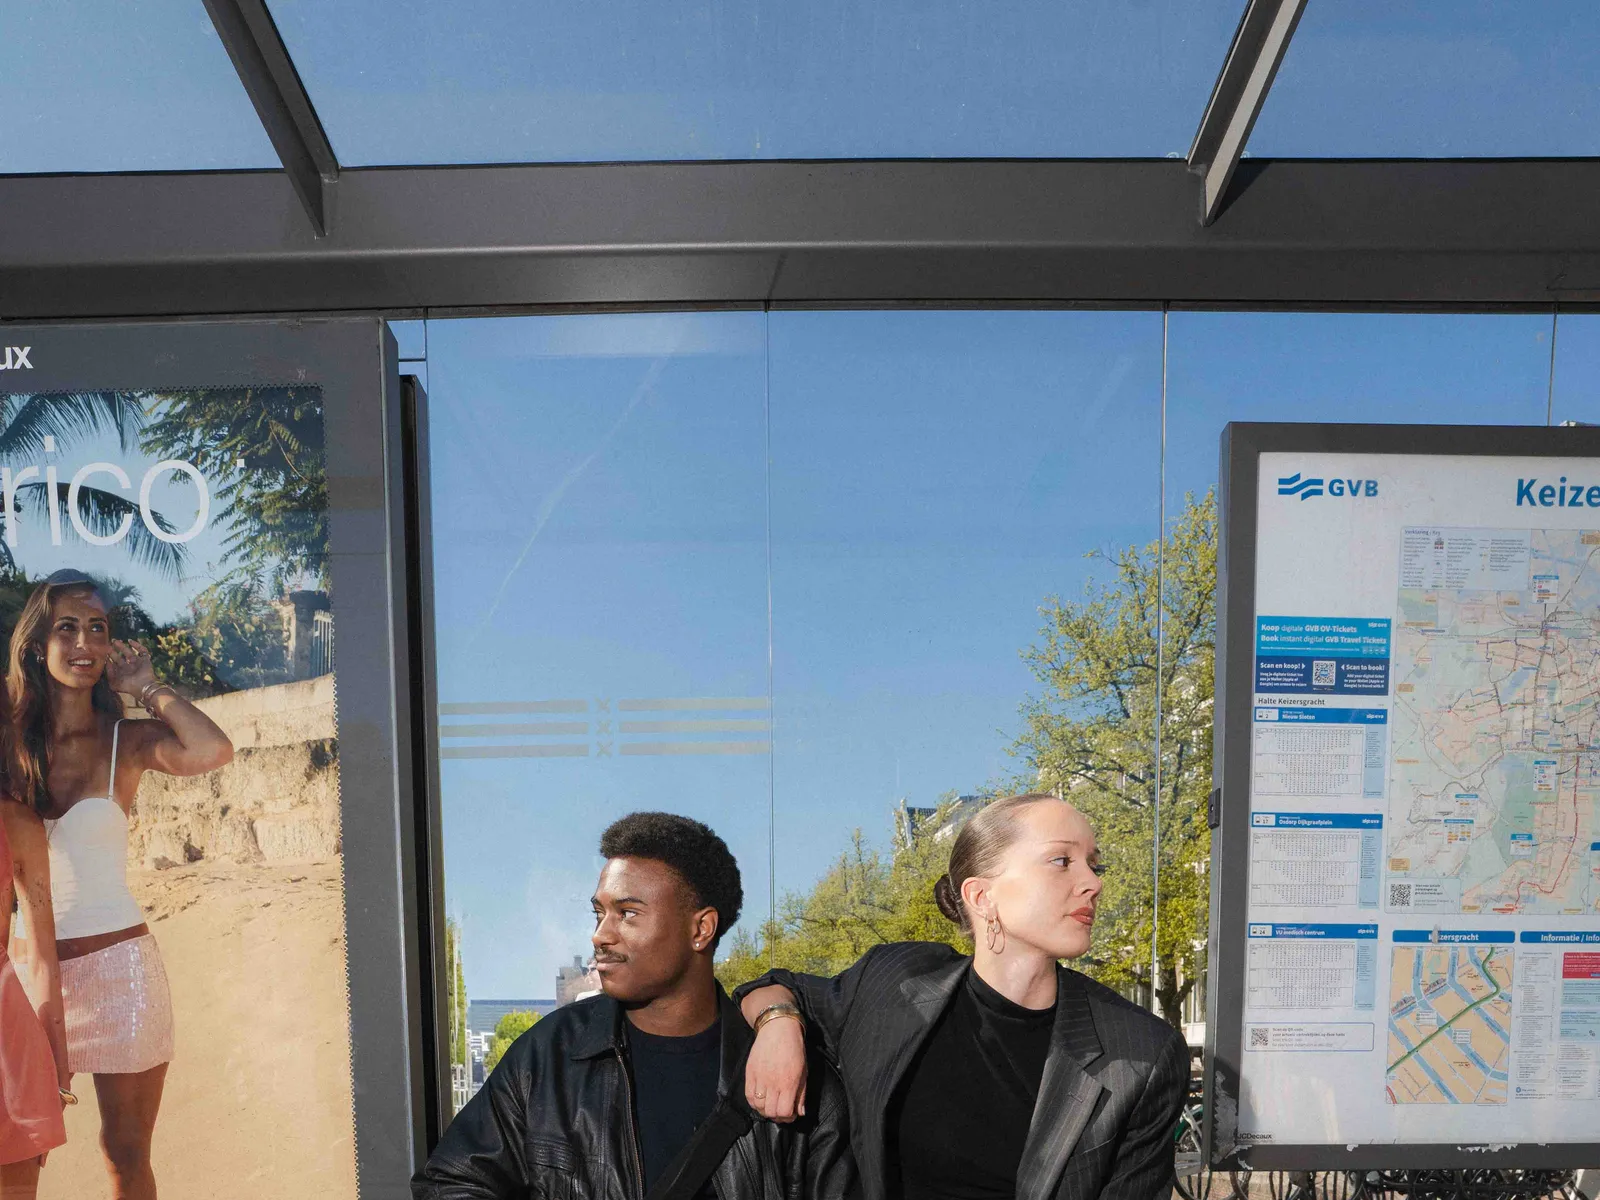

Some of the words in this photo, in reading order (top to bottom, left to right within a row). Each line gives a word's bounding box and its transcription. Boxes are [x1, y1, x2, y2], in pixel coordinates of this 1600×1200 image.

[1328, 478, 1378, 497] GVB
[1516, 476, 1600, 508] Keize
[1262, 624, 1280, 632] Koop
[1281, 625, 1303, 633] digitale
[1304, 636, 1324, 644] digital
[1278, 698, 1325, 706] Keizersgracht
[1428, 934, 1479, 942] Kzersgracht
